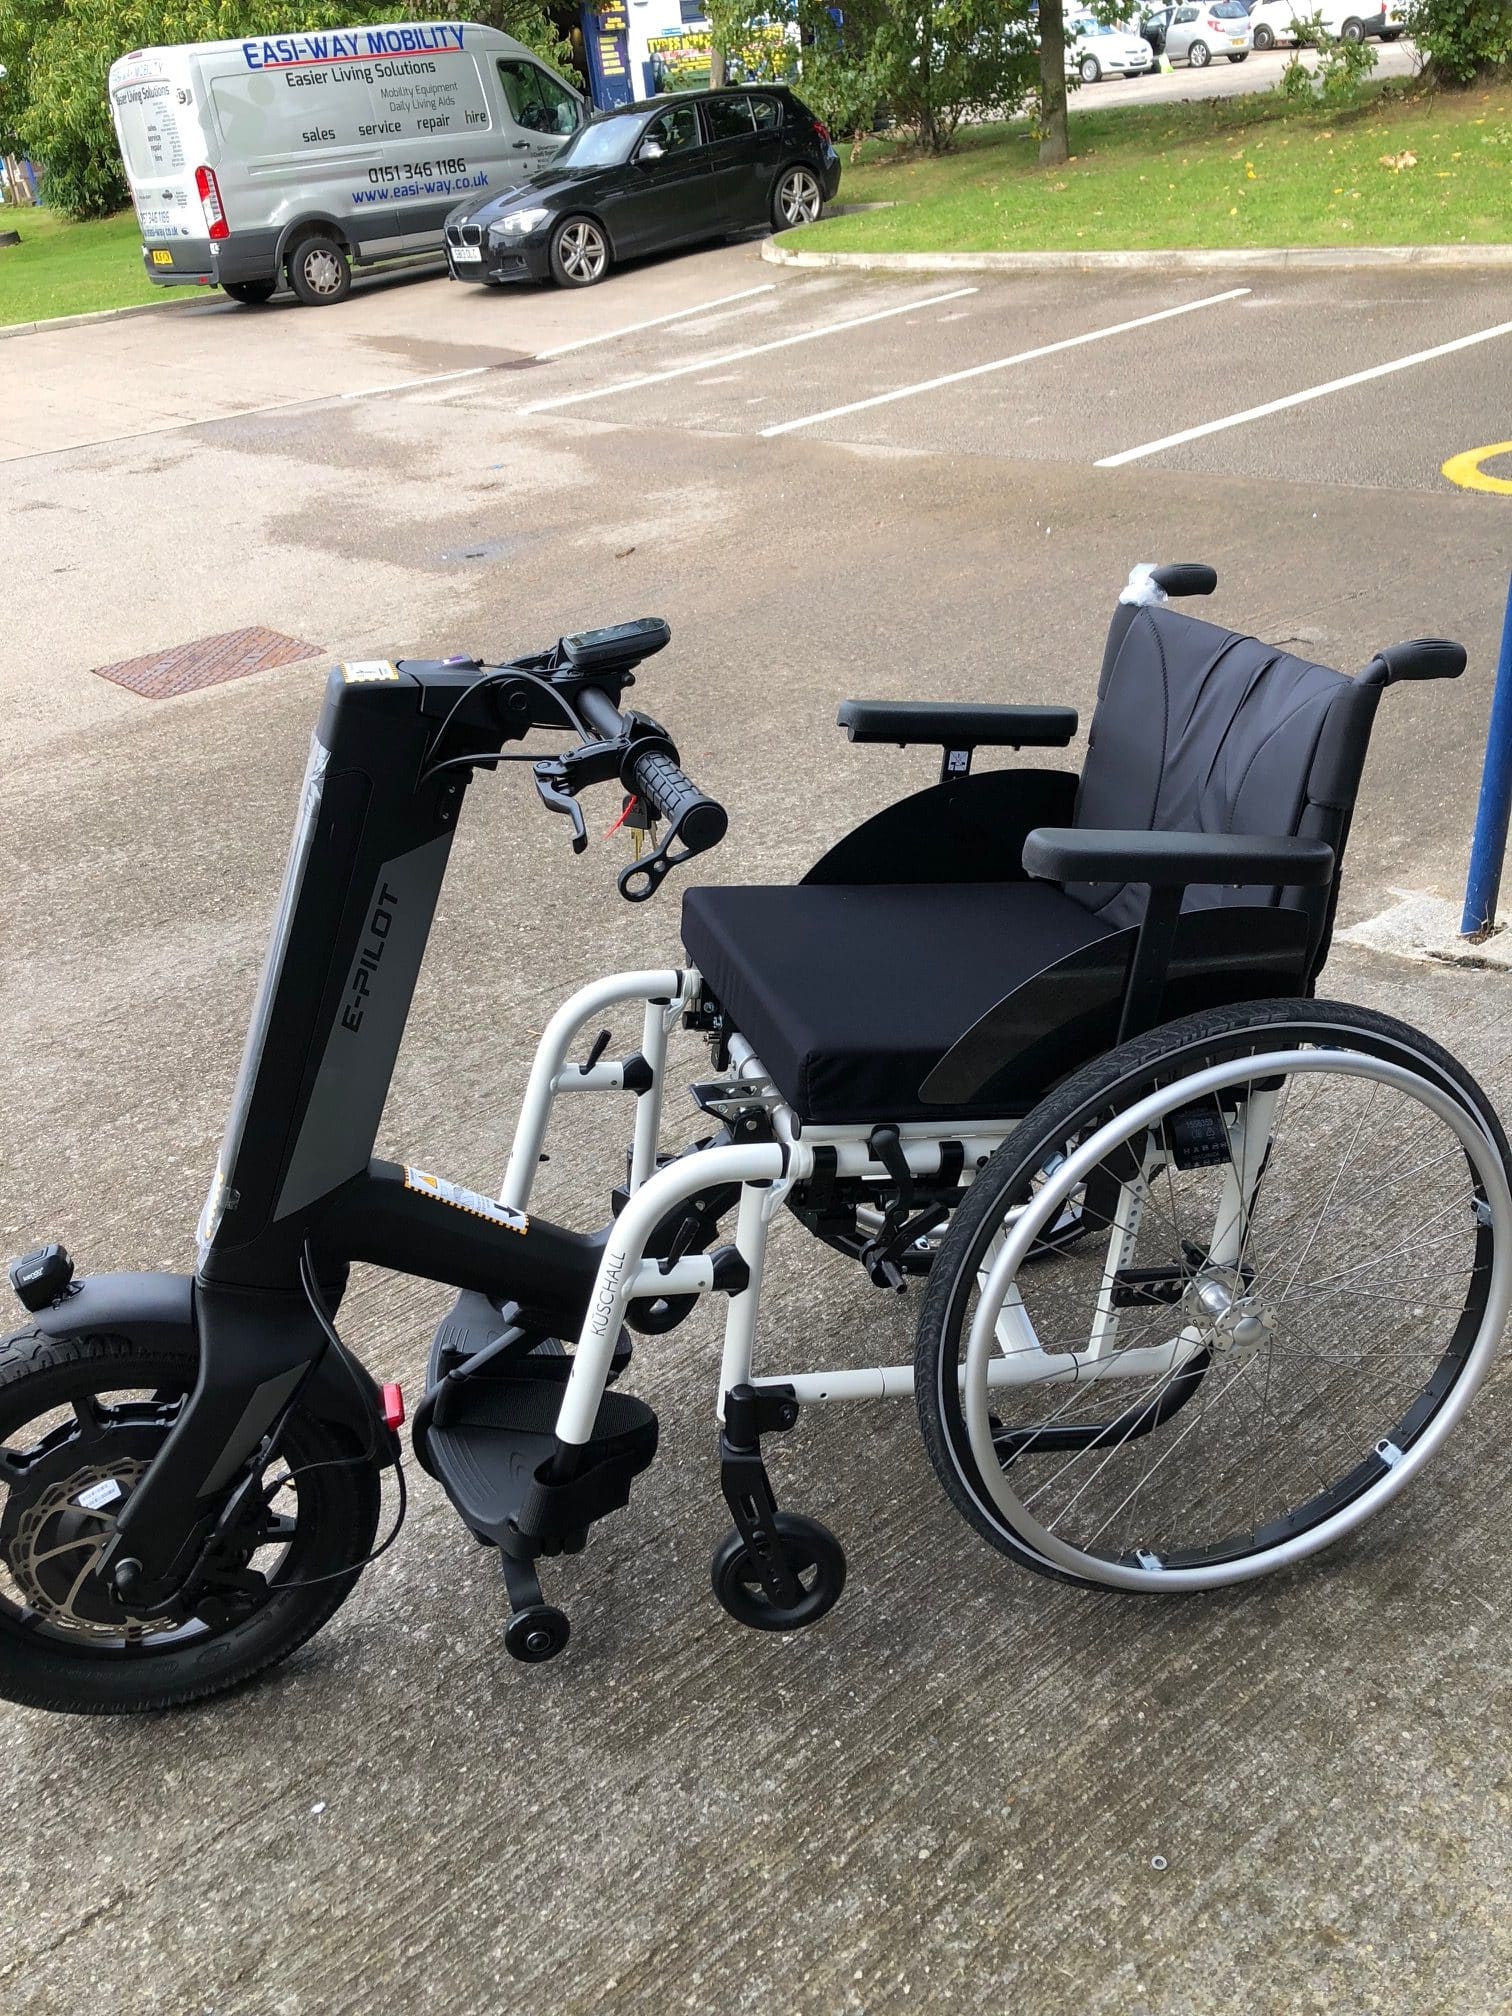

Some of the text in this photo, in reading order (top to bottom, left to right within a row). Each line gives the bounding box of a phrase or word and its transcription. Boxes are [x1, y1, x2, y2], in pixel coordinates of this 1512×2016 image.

[242, 25, 464, 69] EASI-WAY MOBILITY
[286, 60, 436, 87] Easier Living Solutions
[142, 85, 170, 100] Solutions
[380, 82, 458, 100] Mobility Equipment
[390, 95, 456, 112] Daily Living Aids
[302, 110, 487, 142] sales service repair hire
[368, 157, 467, 184] 0151 346 1186
[352, 171, 489, 204] www.easi-way.co.uk
[341, 883, 399, 1033] E-PILOT
[591, 1252, 626, 1337] KÜSCHALL
